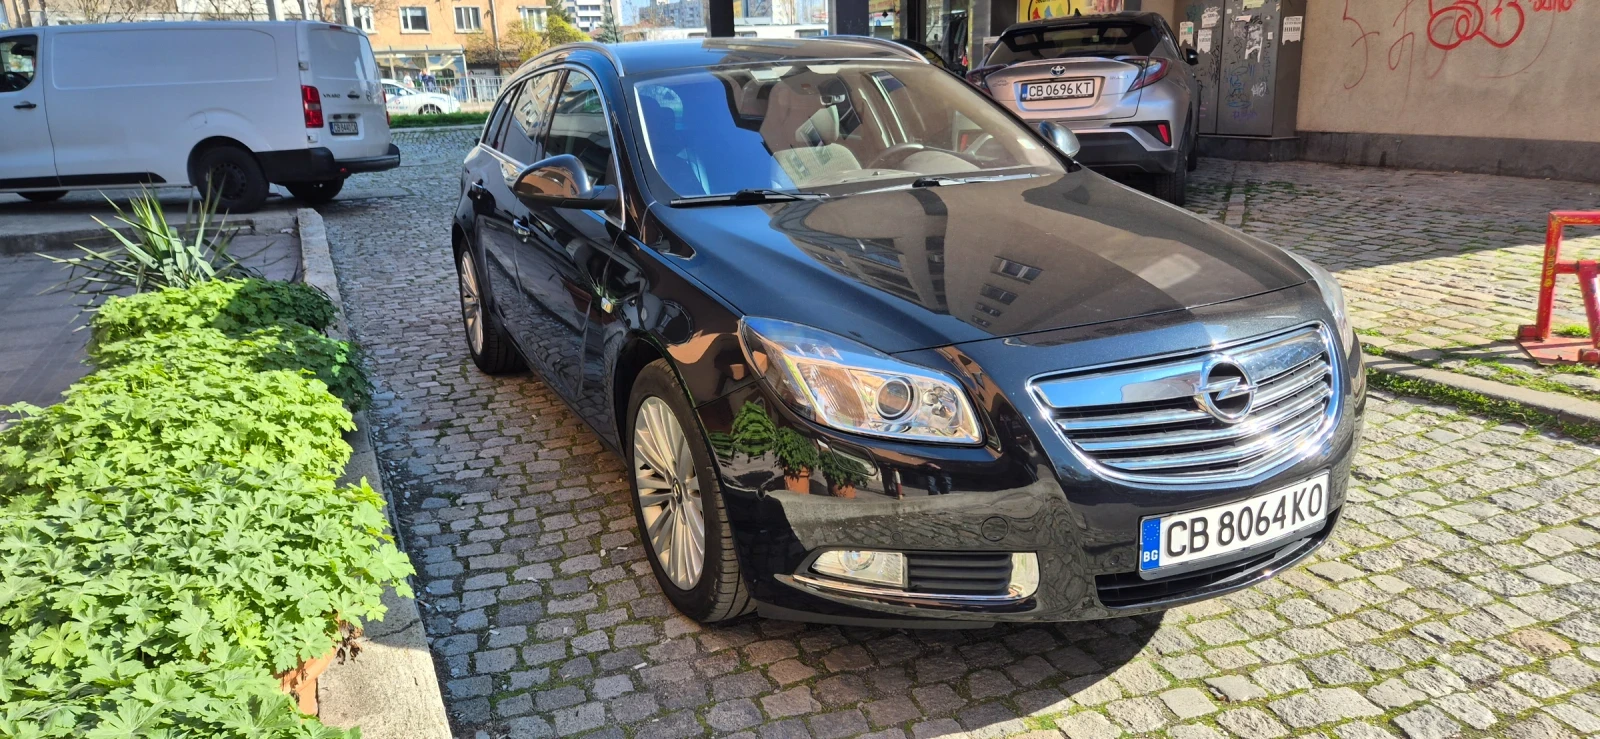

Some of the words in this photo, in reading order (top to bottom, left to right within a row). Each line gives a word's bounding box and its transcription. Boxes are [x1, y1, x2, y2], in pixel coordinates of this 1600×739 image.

[1029, 85, 1043, 97] CB
[1046, 83, 1073, 96] 0696
[1076, 82, 1091, 94] KT
[1167, 516, 1209, 557] CB
[1217, 495, 1286, 546] 8064
[1292, 483, 1323, 526] KO
[1143, 550, 1158, 562] BG
